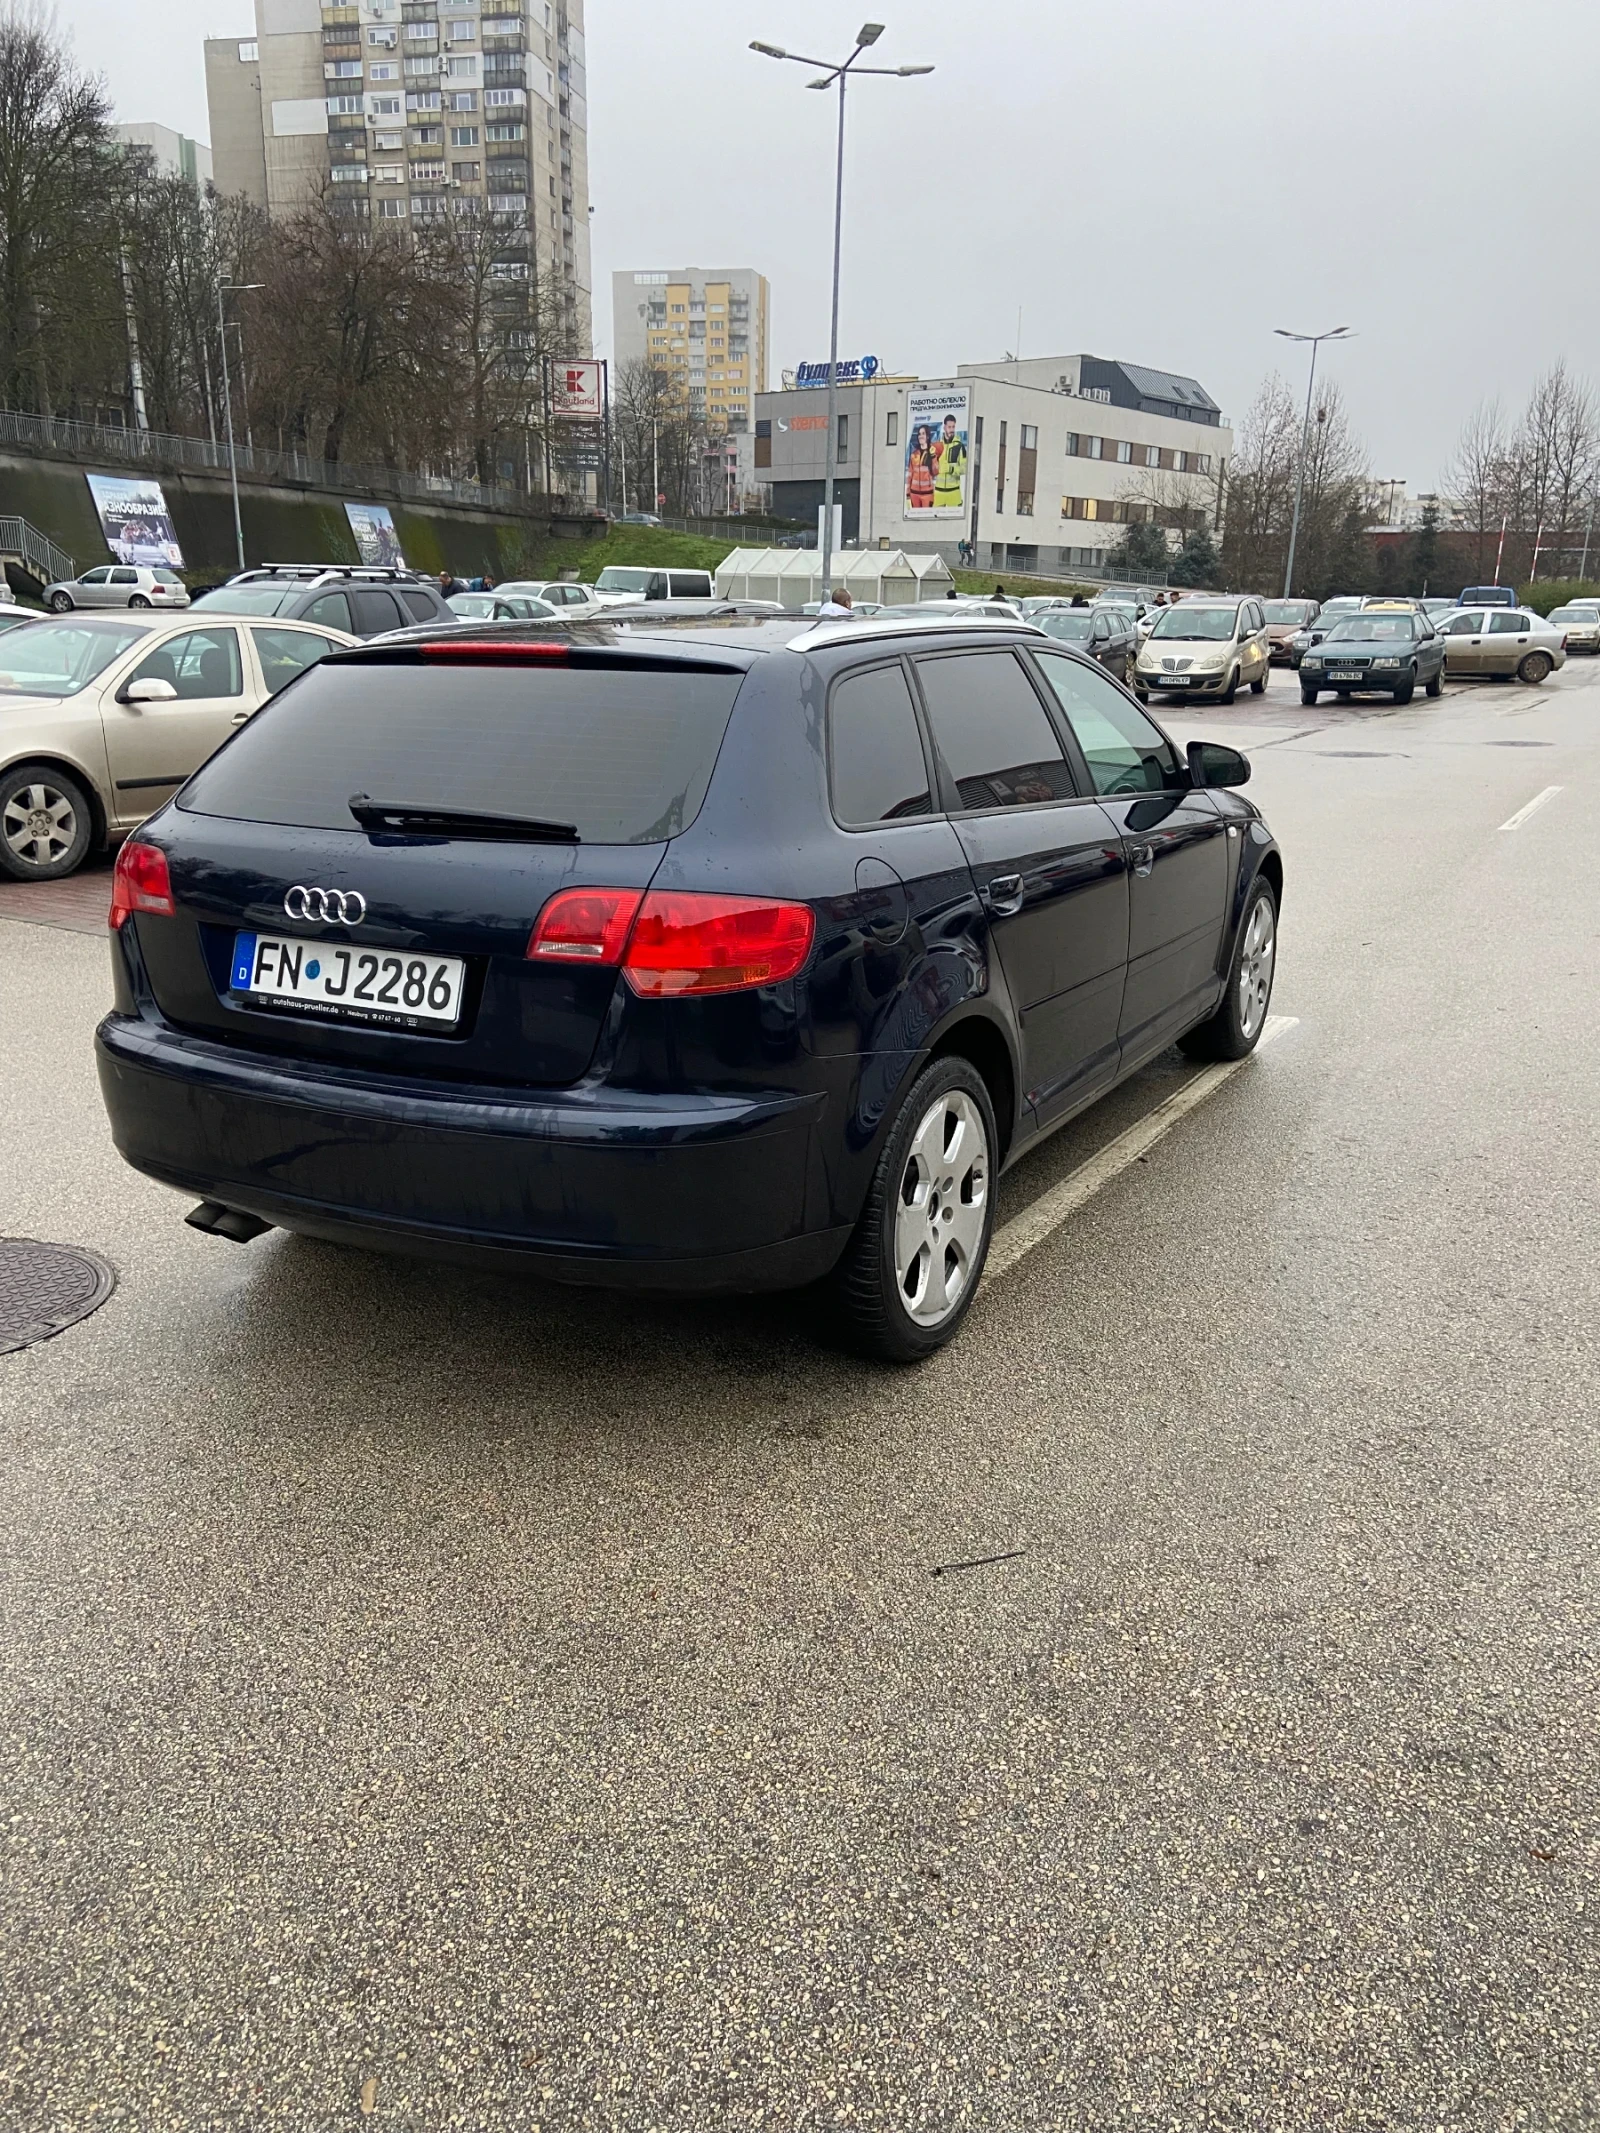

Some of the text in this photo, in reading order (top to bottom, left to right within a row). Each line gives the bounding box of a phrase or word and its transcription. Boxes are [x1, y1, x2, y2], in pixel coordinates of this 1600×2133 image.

[911, 395, 967, 406] РАБОТНО ОБЛЕКЛО
[238, 967, 248, 980] D
[272, 998, 339, 1014] autohaus-prueller.de
